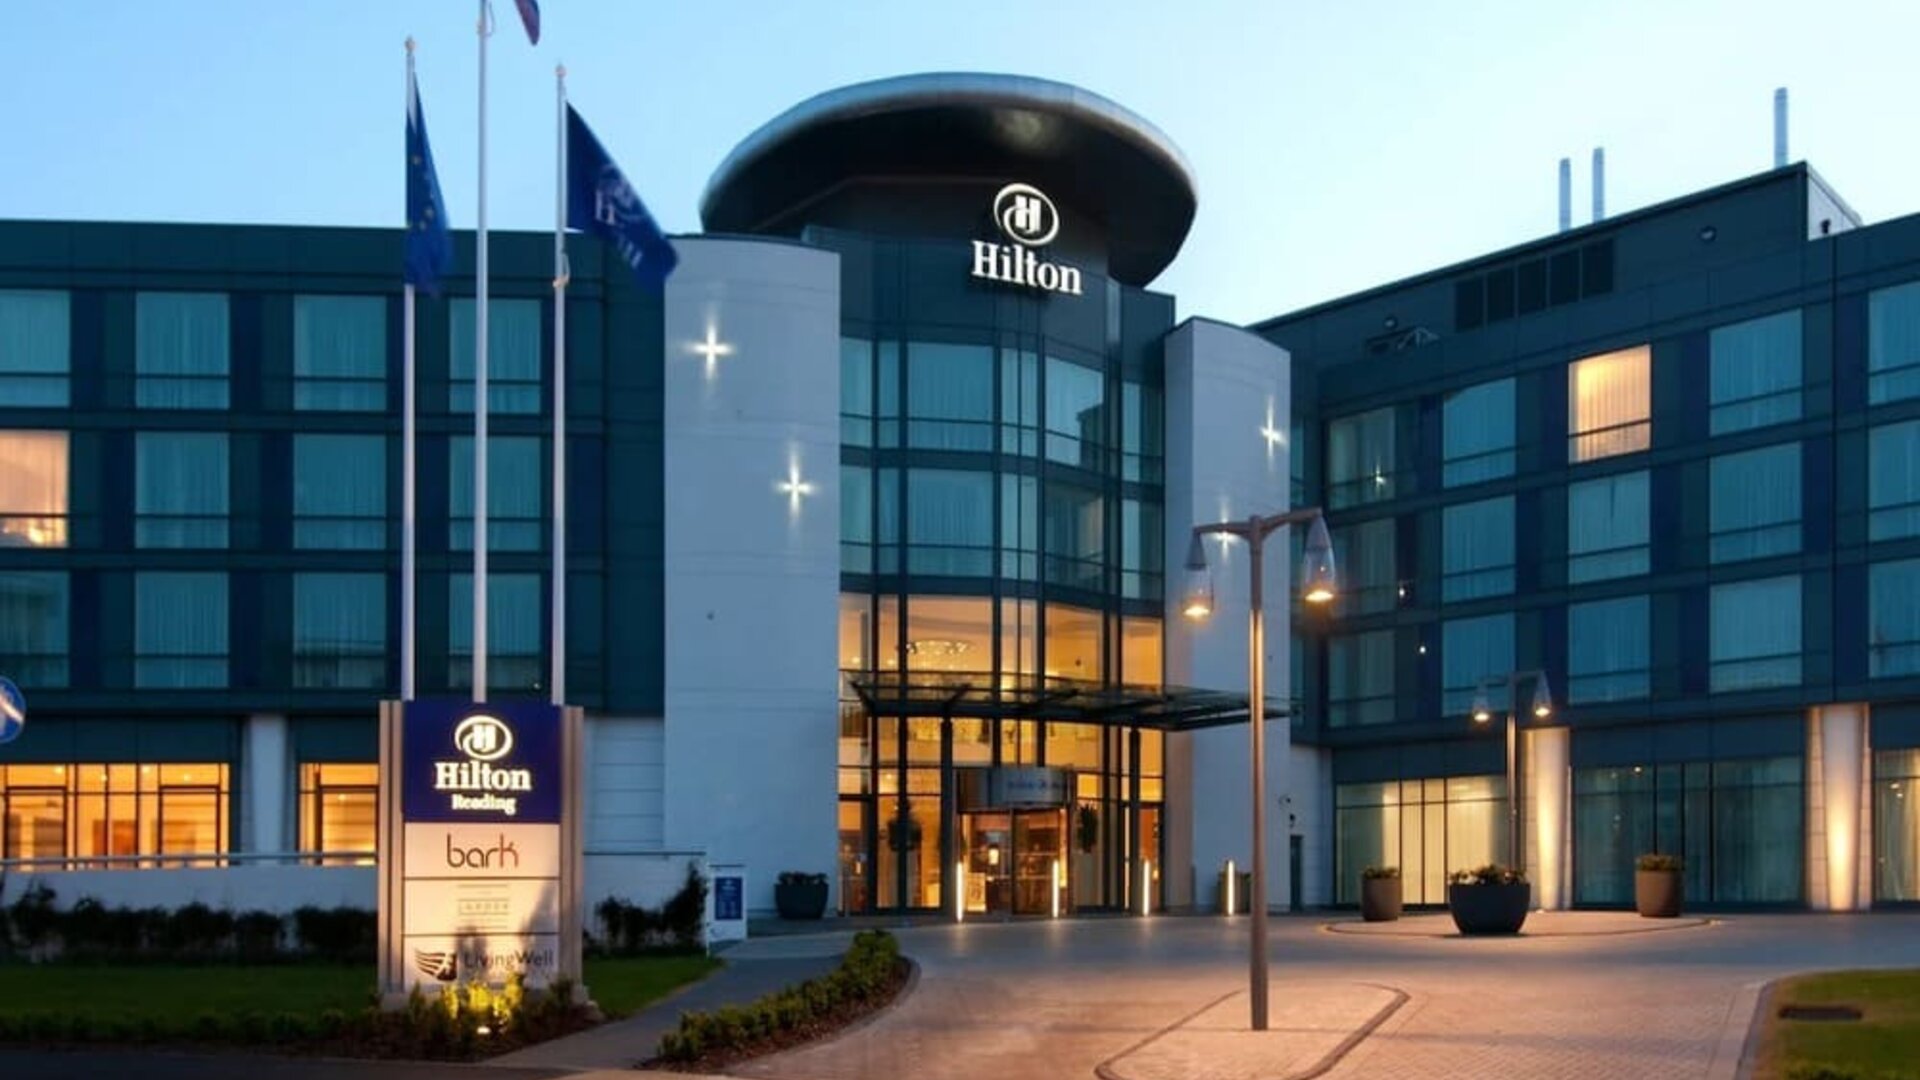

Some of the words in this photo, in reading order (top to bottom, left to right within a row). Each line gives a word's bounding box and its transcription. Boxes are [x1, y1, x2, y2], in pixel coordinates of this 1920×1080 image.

[971, 239, 1082, 296] Hilton
[434, 760, 532, 791] Hilton
[452, 793, 517, 816] Reading
[446, 833, 520, 869] bark
